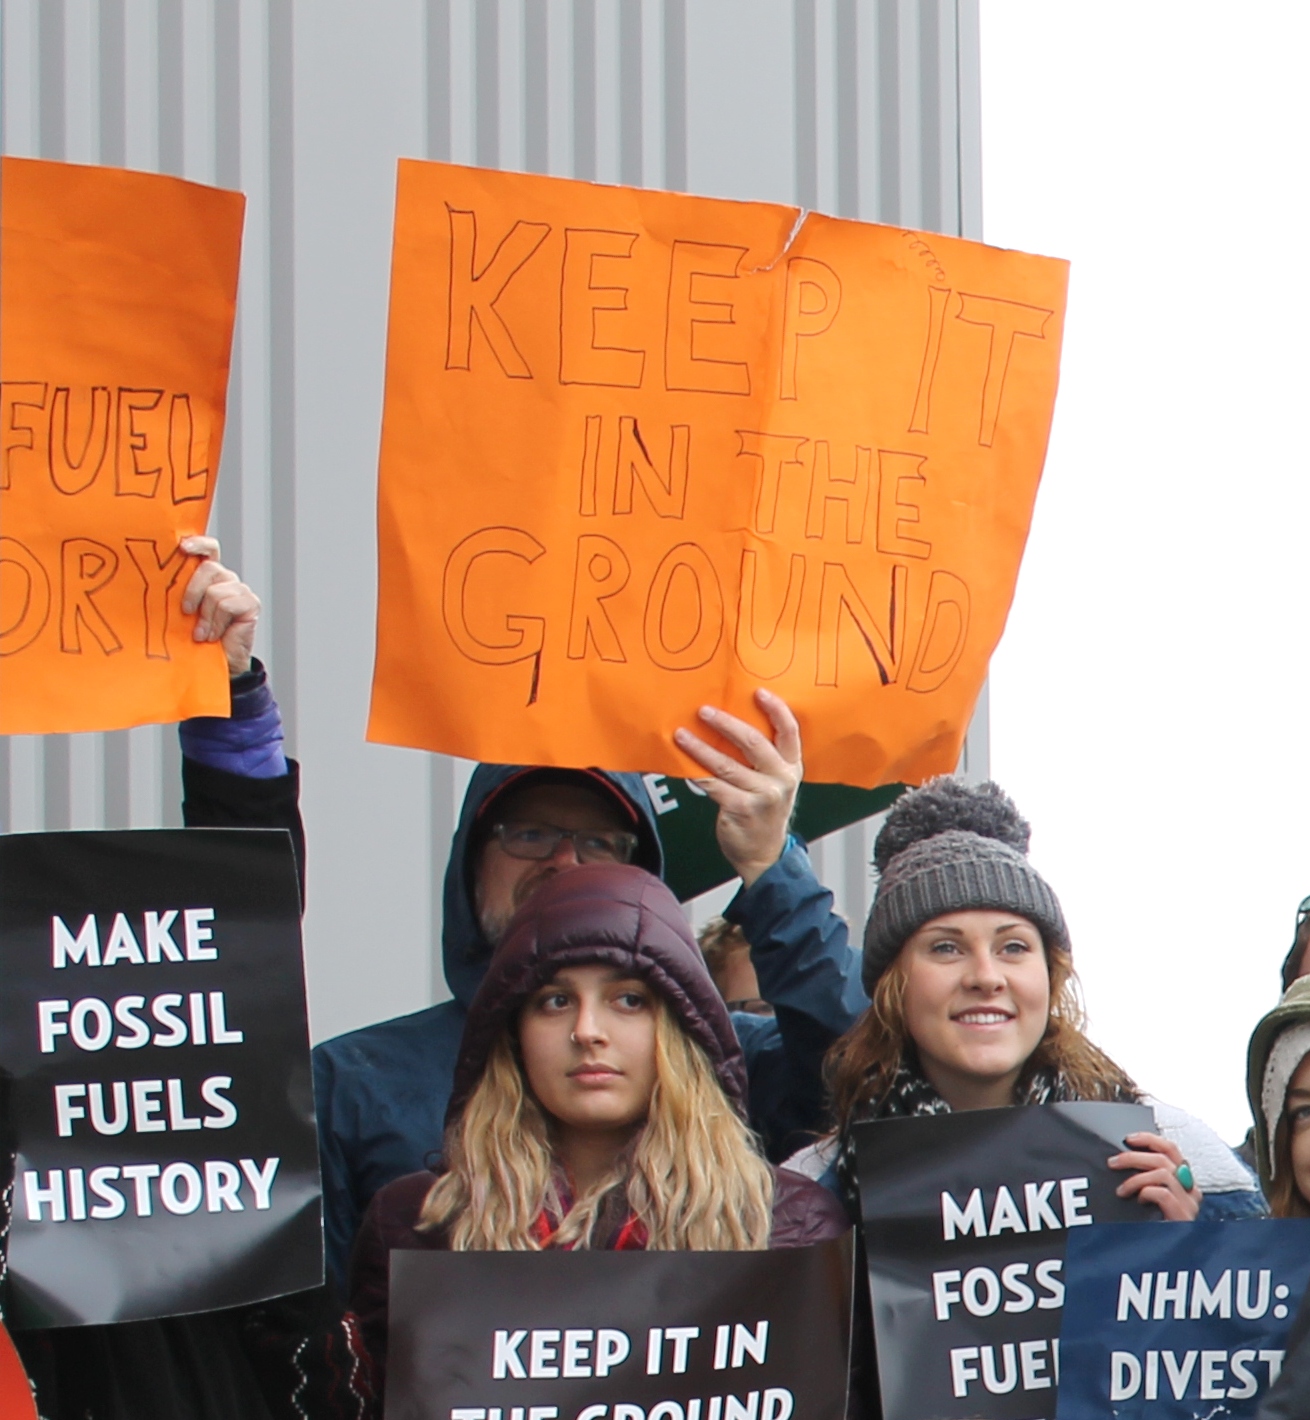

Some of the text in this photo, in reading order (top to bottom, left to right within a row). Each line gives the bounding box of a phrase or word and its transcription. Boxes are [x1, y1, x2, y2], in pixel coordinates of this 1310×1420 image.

[444, 202, 1055, 447] KEEP IT
[578, 414, 932, 558] IN THE
[442, 526, 972, 707] GROUND
[51, 907, 219, 969] MAKE
[37, 991, 244, 1054] FOSSIL
[54, 1075, 238, 1137] FUELS
[23, 1157, 281, 1222] HISTORY
[941, 1177, 1093, 1241] MAKE
[932, 1260, 1066, 1321] FOSS
[1116, 1269, 1290, 1322] NHMU:
[491, 1320, 770, 1380] KEEP IT IN
[950, 1339, 1060, 1398] FUE
